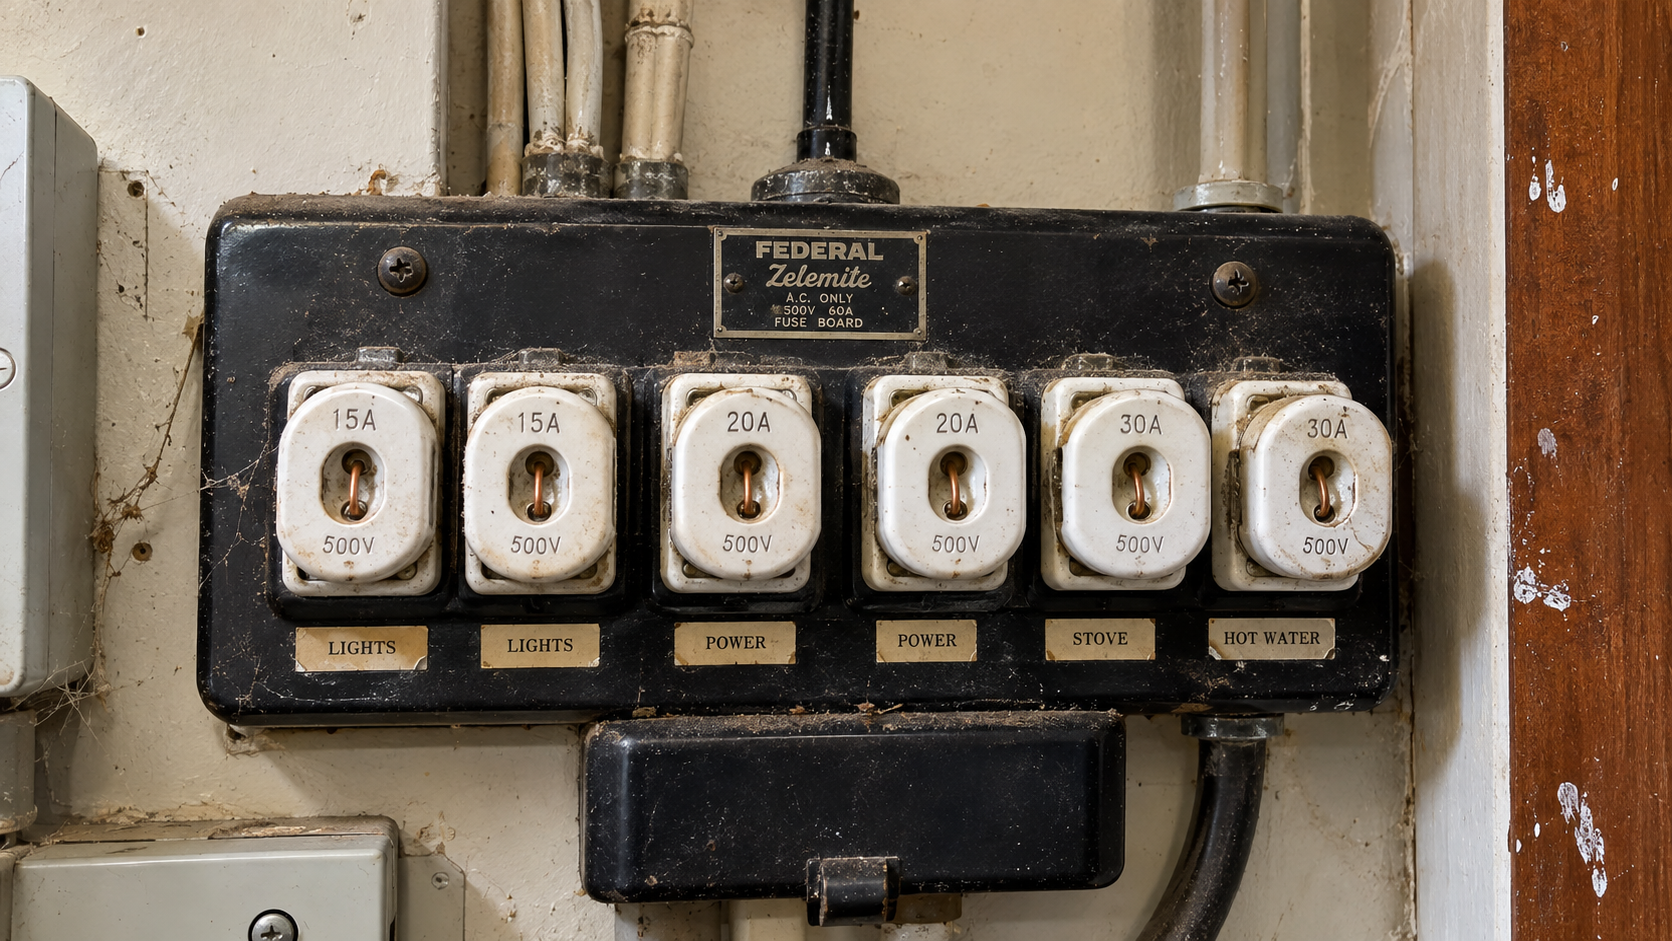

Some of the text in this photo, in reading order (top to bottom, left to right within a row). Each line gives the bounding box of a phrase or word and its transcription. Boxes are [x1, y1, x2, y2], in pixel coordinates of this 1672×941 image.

[756, 241, 884, 261] FEDERAL
[765, 264, 872, 288] Zelemite
[786, 292, 853, 304] A.C. ONLY
[783, 305, 853, 316] 500V 60A
[774, 317, 863, 328] FUSE BOARD
[333, 408, 377, 431] 15A
[518, 412, 561, 434] 15A
[727, 411, 771, 433] 20A
[936, 413, 979, 434] 20A
[1120, 414, 1163, 435] 30A
[1307, 418, 1349, 439] 30A
[322, 536, 375, 555] 500V
[510, 536, 562, 554] 500V
[722, 534, 773, 553] 500V
[931, 534, 980, 553] 500V
[1115, 534, 1164, 553] 500V
[1302, 536, 1349, 555] 500V
[328, 640, 397, 655] LIGHTS
[507, 638, 574, 653] LIGHTS
[706, 635, 767, 650] POWER
[897, 633, 957, 648] POWER
[1072, 631, 1129, 646] STOVE
[1223, 631, 1321, 646] HOT WATER
